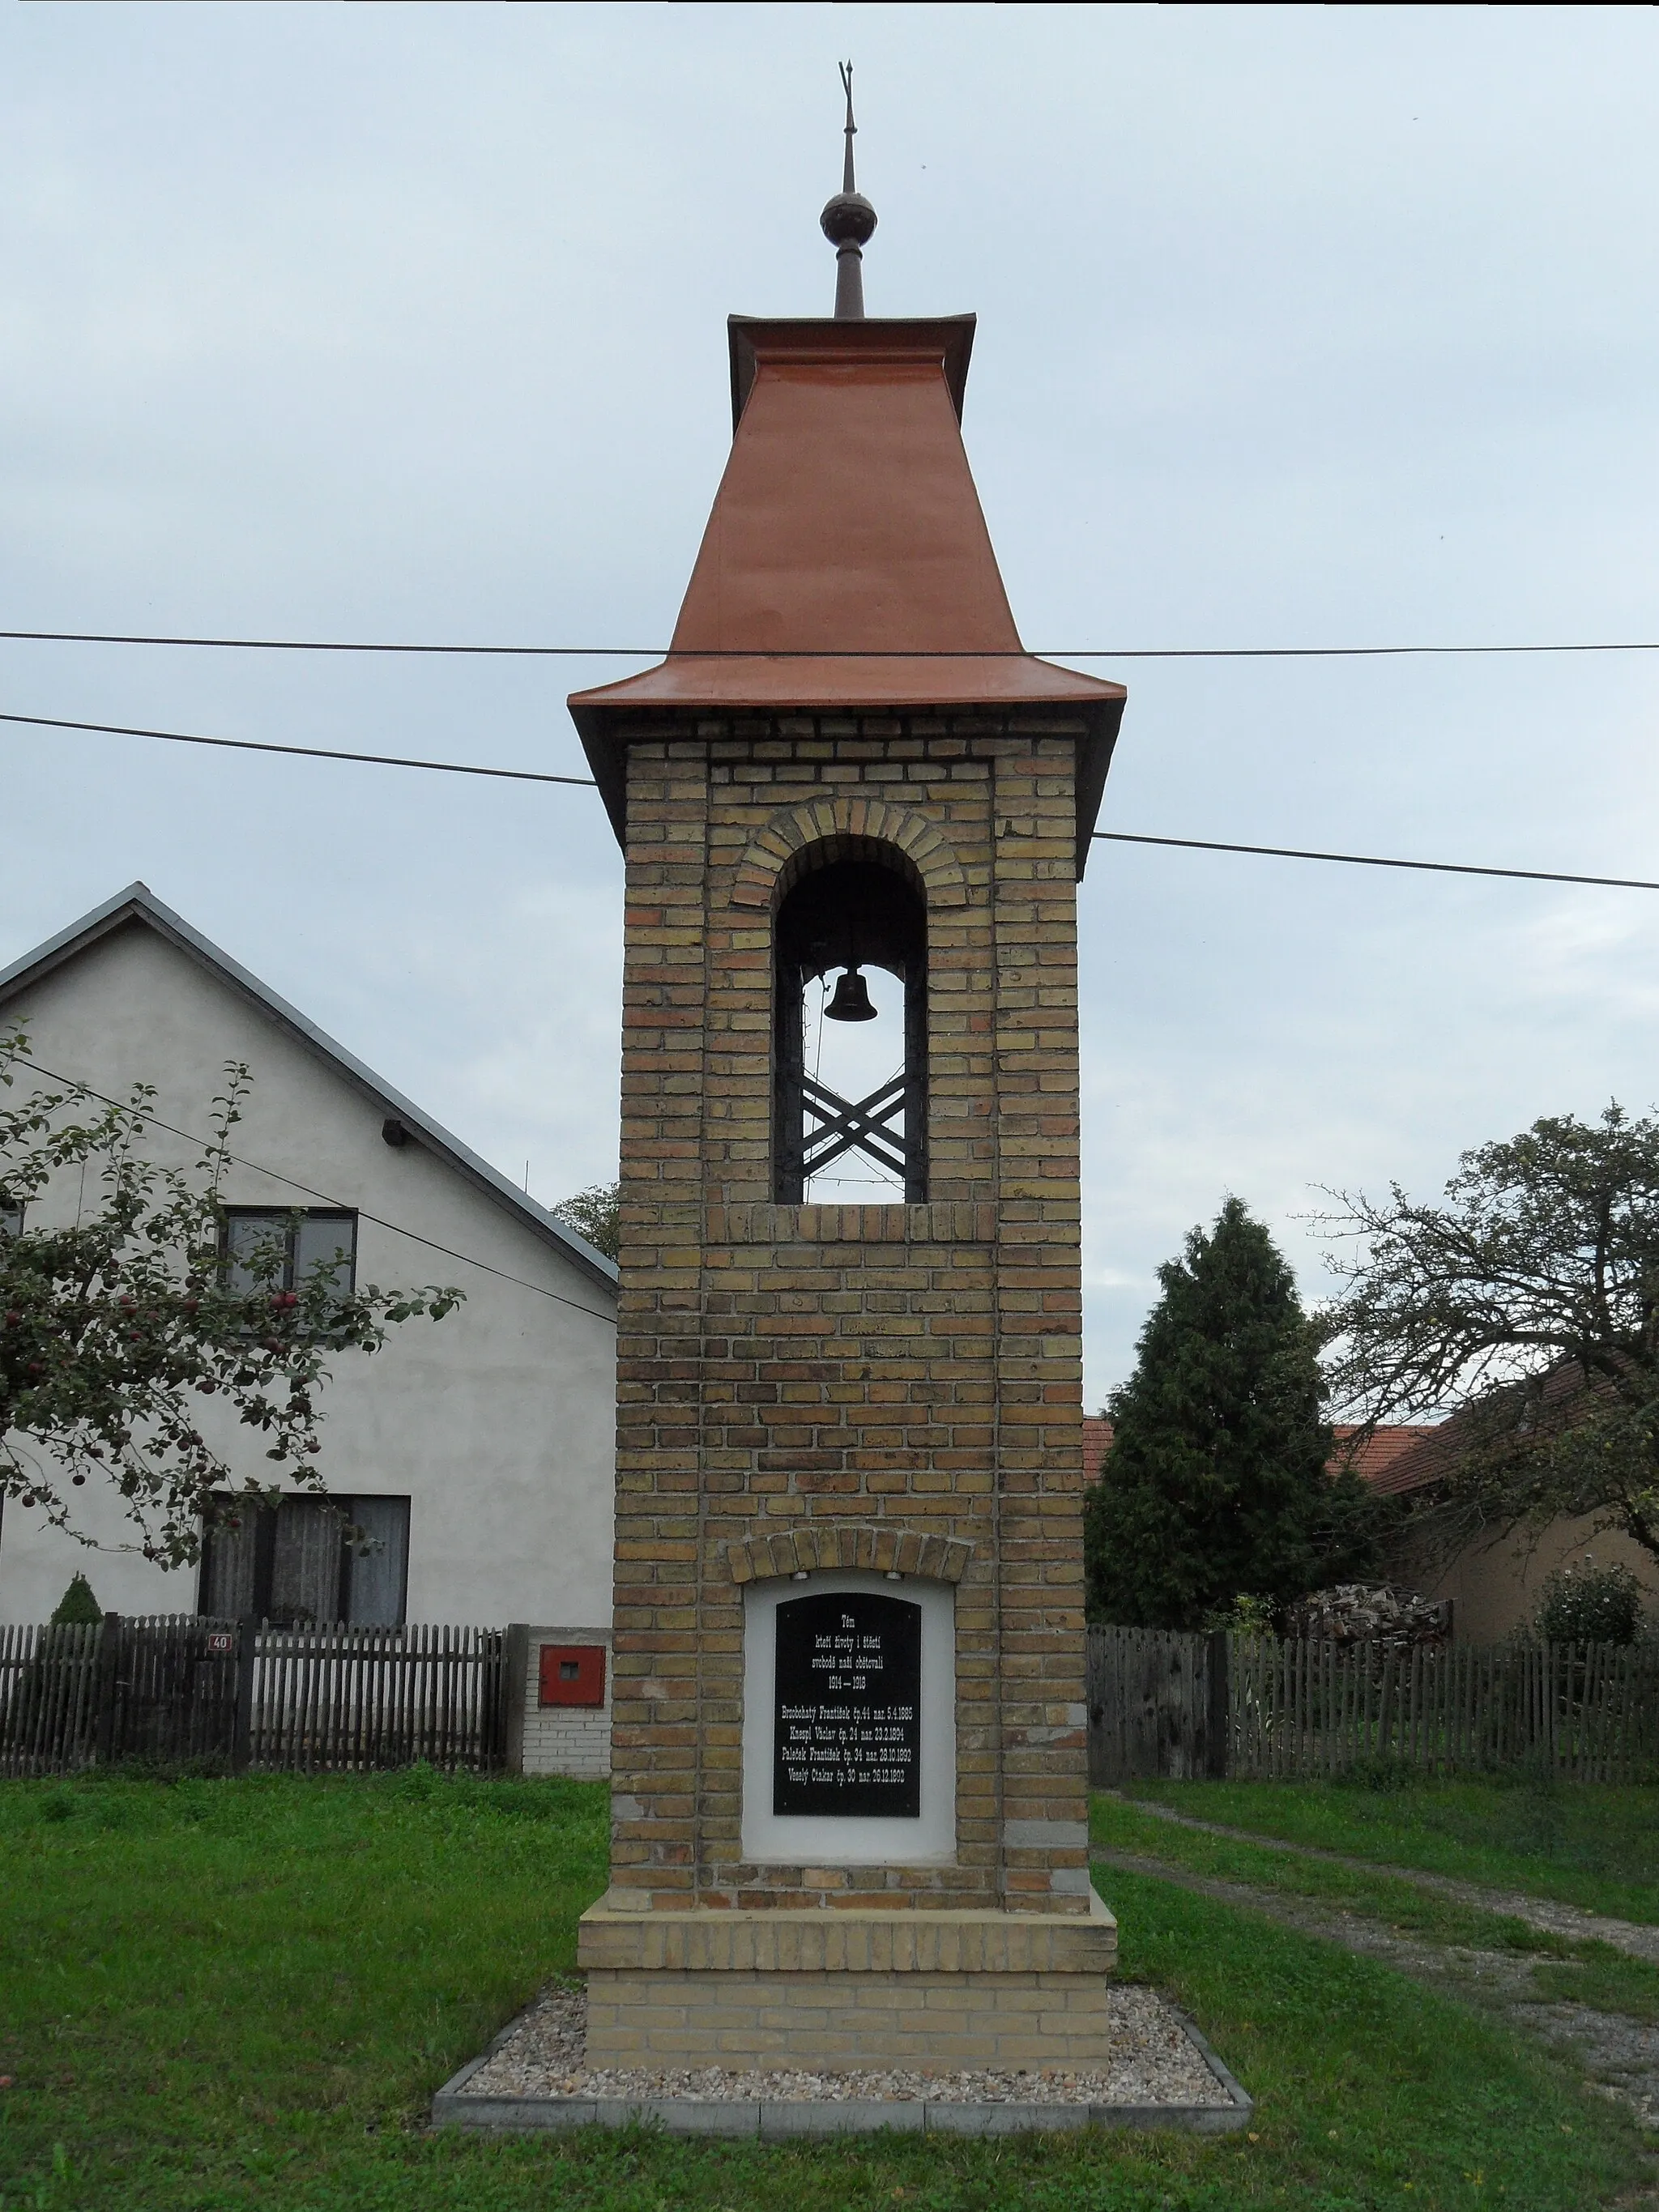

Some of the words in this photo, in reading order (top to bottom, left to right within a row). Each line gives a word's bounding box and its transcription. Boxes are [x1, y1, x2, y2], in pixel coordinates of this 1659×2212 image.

[213, 1637, 227, 1648] 40
[815, 1634, 831, 1648] kteří
[834, 1635, 854, 1652] životy
[856, 1634, 859, 1648] i
[863, 1635, 881, 1649] štěstí
[838, 1656, 853, 1669] naší
[855, 1656, 884, 1669] obětovali
[829, 1676, 842, 1690] 1914
[852, 1676, 866, 1690] 1918
[819, 1705, 851, 1720] František
[873, 1710, 885, 1720] nar.
[887, 1707, 913, 1720] 5.4.1885
[789, 1726, 812, 1744] Knespl
[815, 1726, 836, 1741] Václav
[838, 1727, 848, 1745] čp.
[849, 1727, 858, 1741] 24
[860, 1730, 873, 1741] nar.
[874, 1727, 904, 1741] 23.2.1894
[809, 1747, 841, 1761] František
[843, 1748, 853, 1766] čp.
[854, 1748, 863, 1762] 34
[865, 1751, 878, 1761] nar.
[837, 1769, 846, 1787] čp.
[847, 1768, 855, 1783] 30
[859, 1772, 871, 1783] nar.
